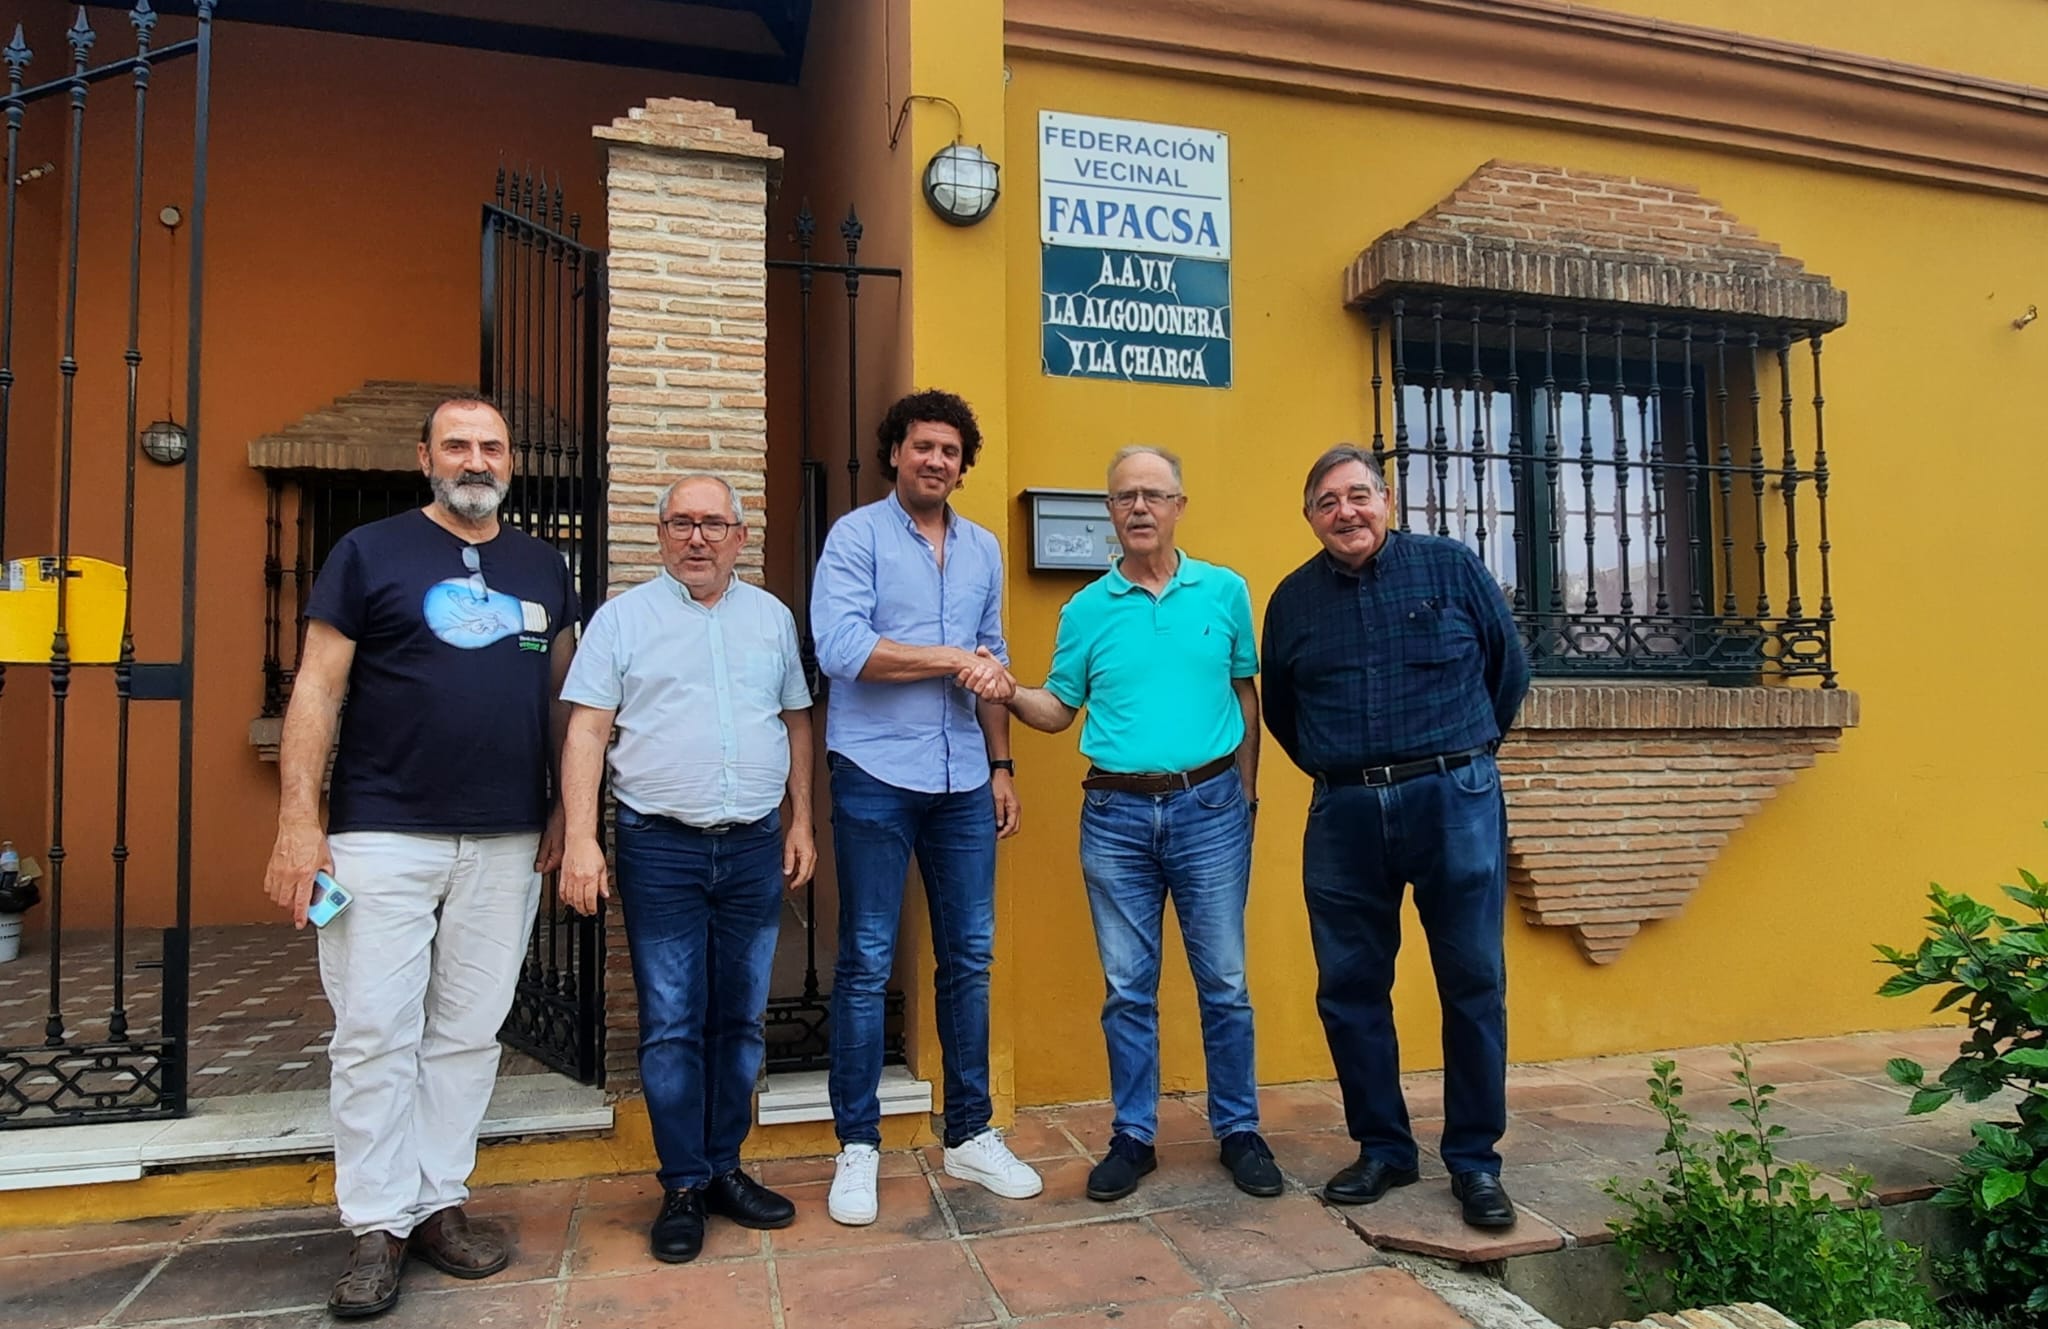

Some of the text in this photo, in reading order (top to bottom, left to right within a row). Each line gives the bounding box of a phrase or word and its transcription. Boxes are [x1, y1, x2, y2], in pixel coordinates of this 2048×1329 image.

[1045, 126, 1215, 164] FEDERACIÓN
[1074, 158, 1188, 188] VECINAL
[1048, 195, 1220, 247] FAPACSA
[1048, 293, 1226, 339] LA ALGODONERA
[1120, 344, 1207, 380] CHARCA
